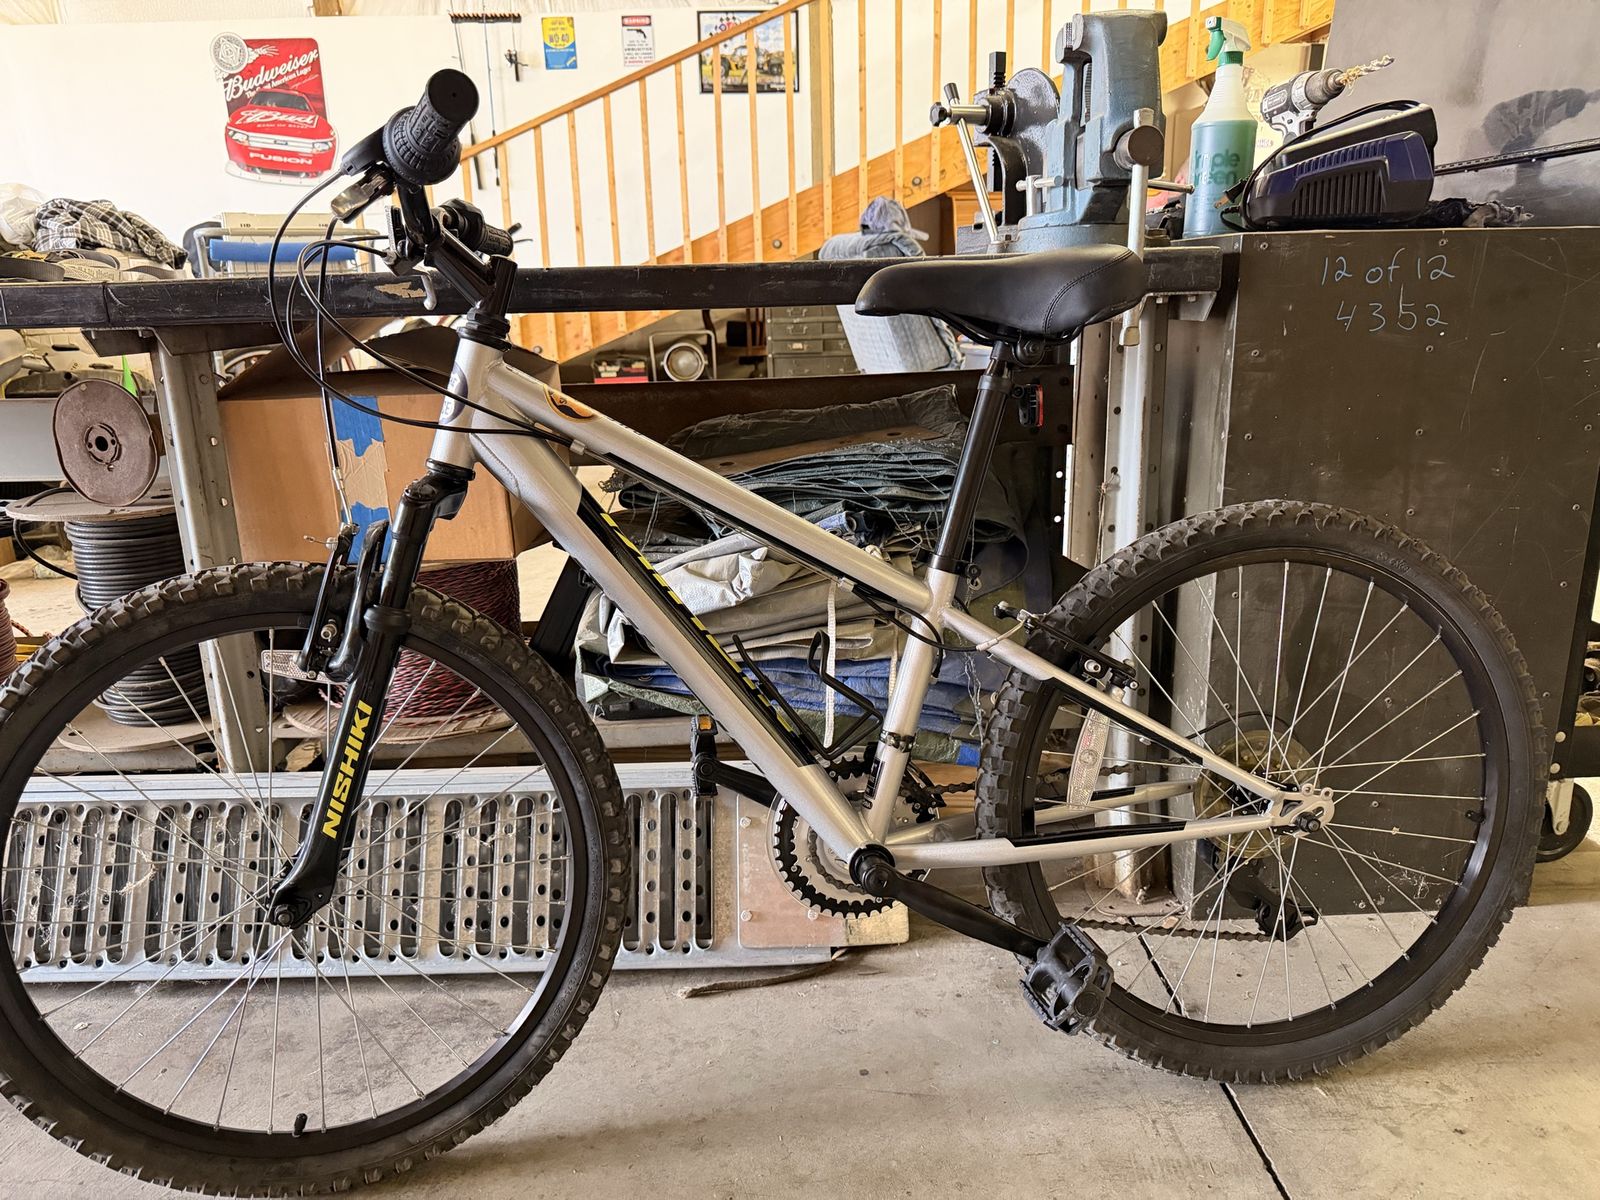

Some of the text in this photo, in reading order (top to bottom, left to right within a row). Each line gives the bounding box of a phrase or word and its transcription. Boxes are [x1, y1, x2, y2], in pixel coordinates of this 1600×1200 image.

[223, 49, 319, 102] Budweiser
[235, 109, 319, 128] Bud
[249, 152, 313, 165] FUSION
[1321, 247, 1456, 286] 12 of 12
[322, 700, 374, 839] NISHIKI
